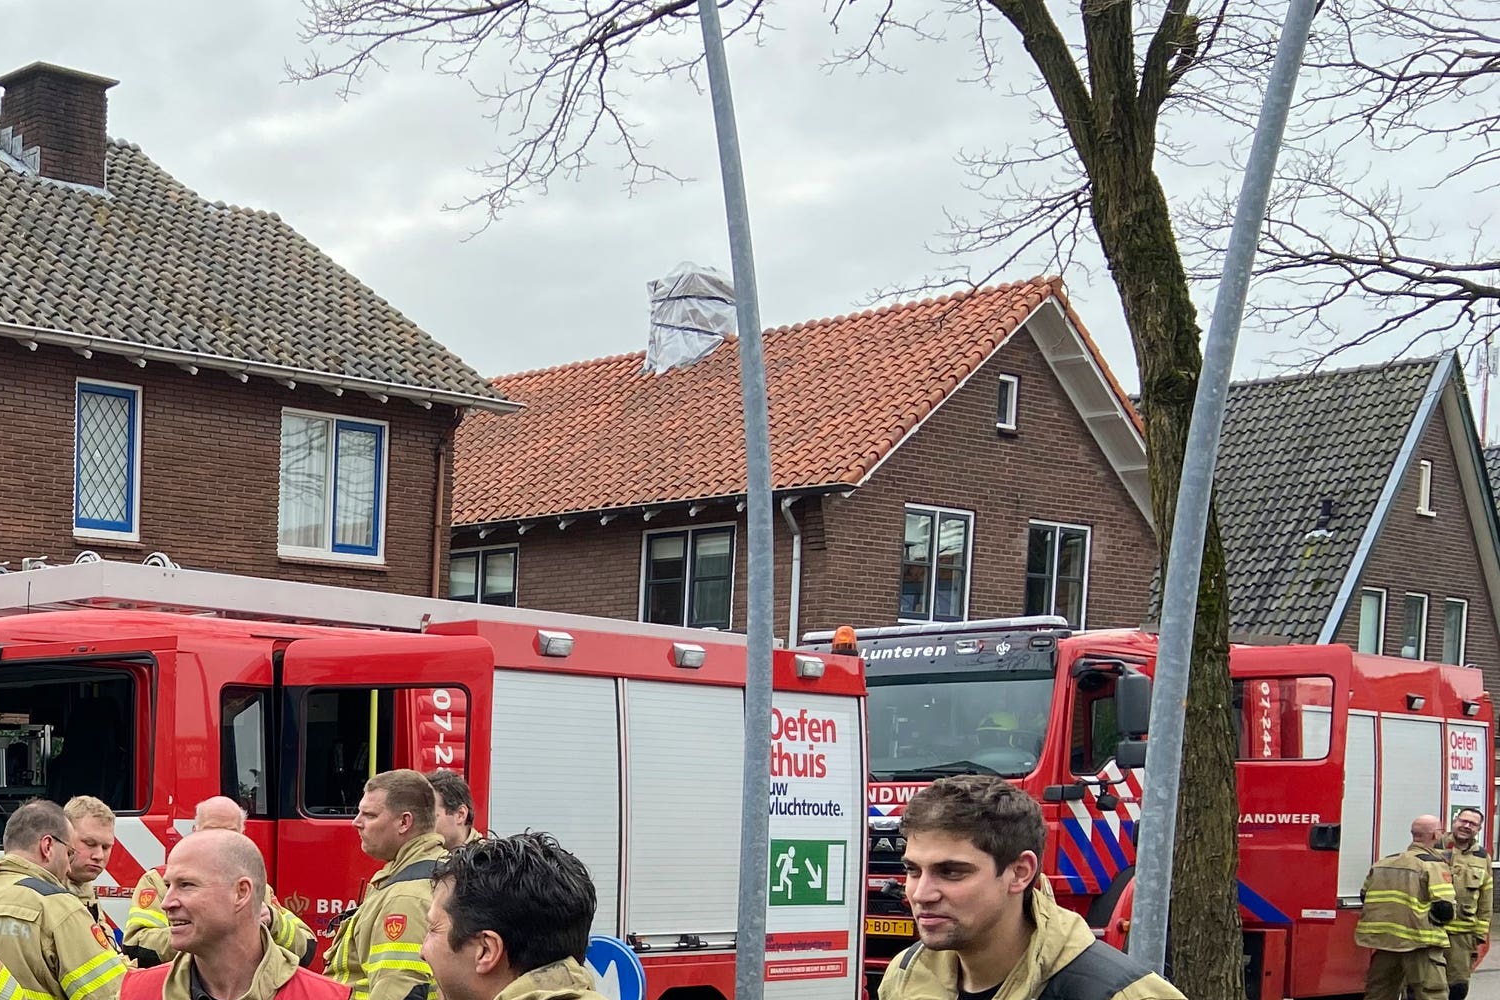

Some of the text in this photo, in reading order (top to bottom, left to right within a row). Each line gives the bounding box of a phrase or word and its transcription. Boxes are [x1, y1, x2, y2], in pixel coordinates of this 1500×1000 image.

[860, 645, 948, 661] Lunteren
[433, 689, 453, 771] 07-2
[1450, 731, 1477, 751] Oefen
[771, 742, 826, 778] thuis
[1451, 751, 1474, 771] thuis
[769, 798, 844, 816] vluchtroute.
